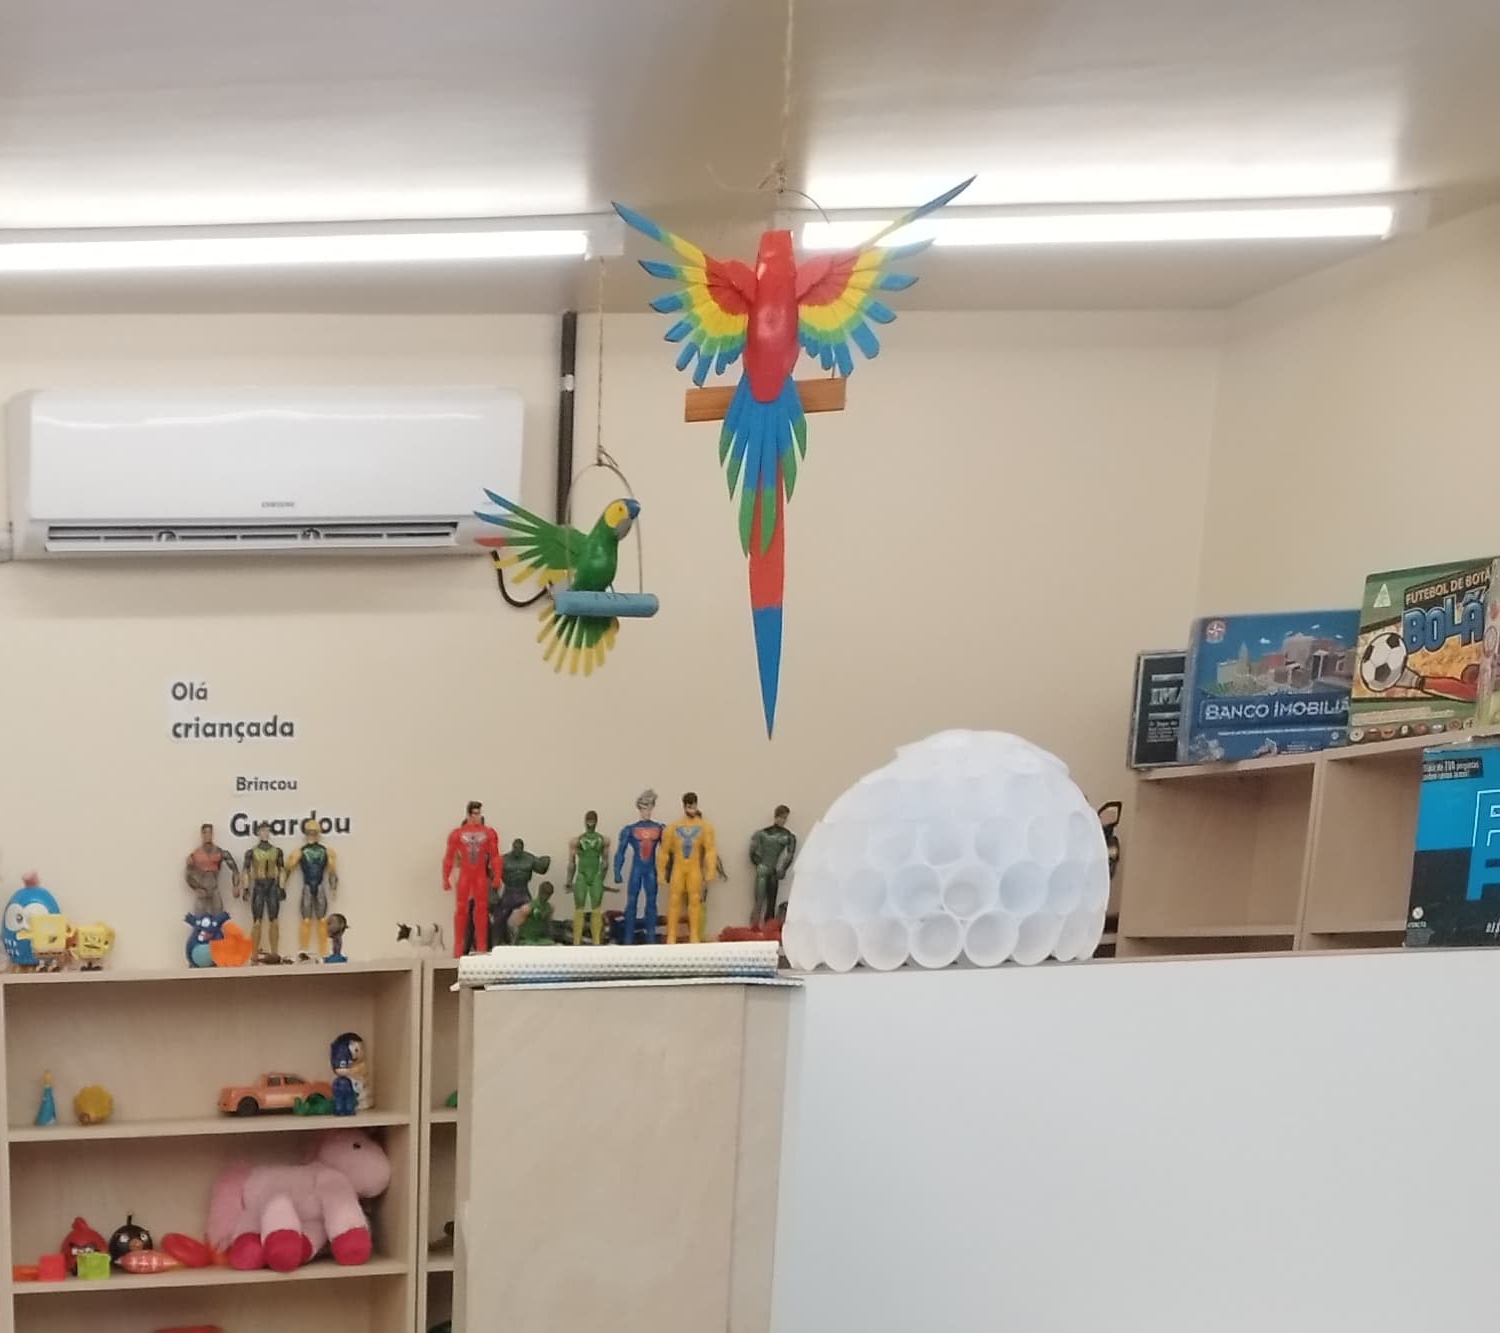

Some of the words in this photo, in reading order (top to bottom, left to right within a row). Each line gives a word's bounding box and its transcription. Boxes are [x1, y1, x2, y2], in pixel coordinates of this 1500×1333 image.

[1406, 583, 1450, 605] FUTEBOL
[1450, 577, 1464, 591] DE
[171, 681, 208, 701] Olá
[1205, 702, 1270, 720] BANCO
[172, 714, 295, 743] criançada
[236, 776, 298, 792] Brincou
